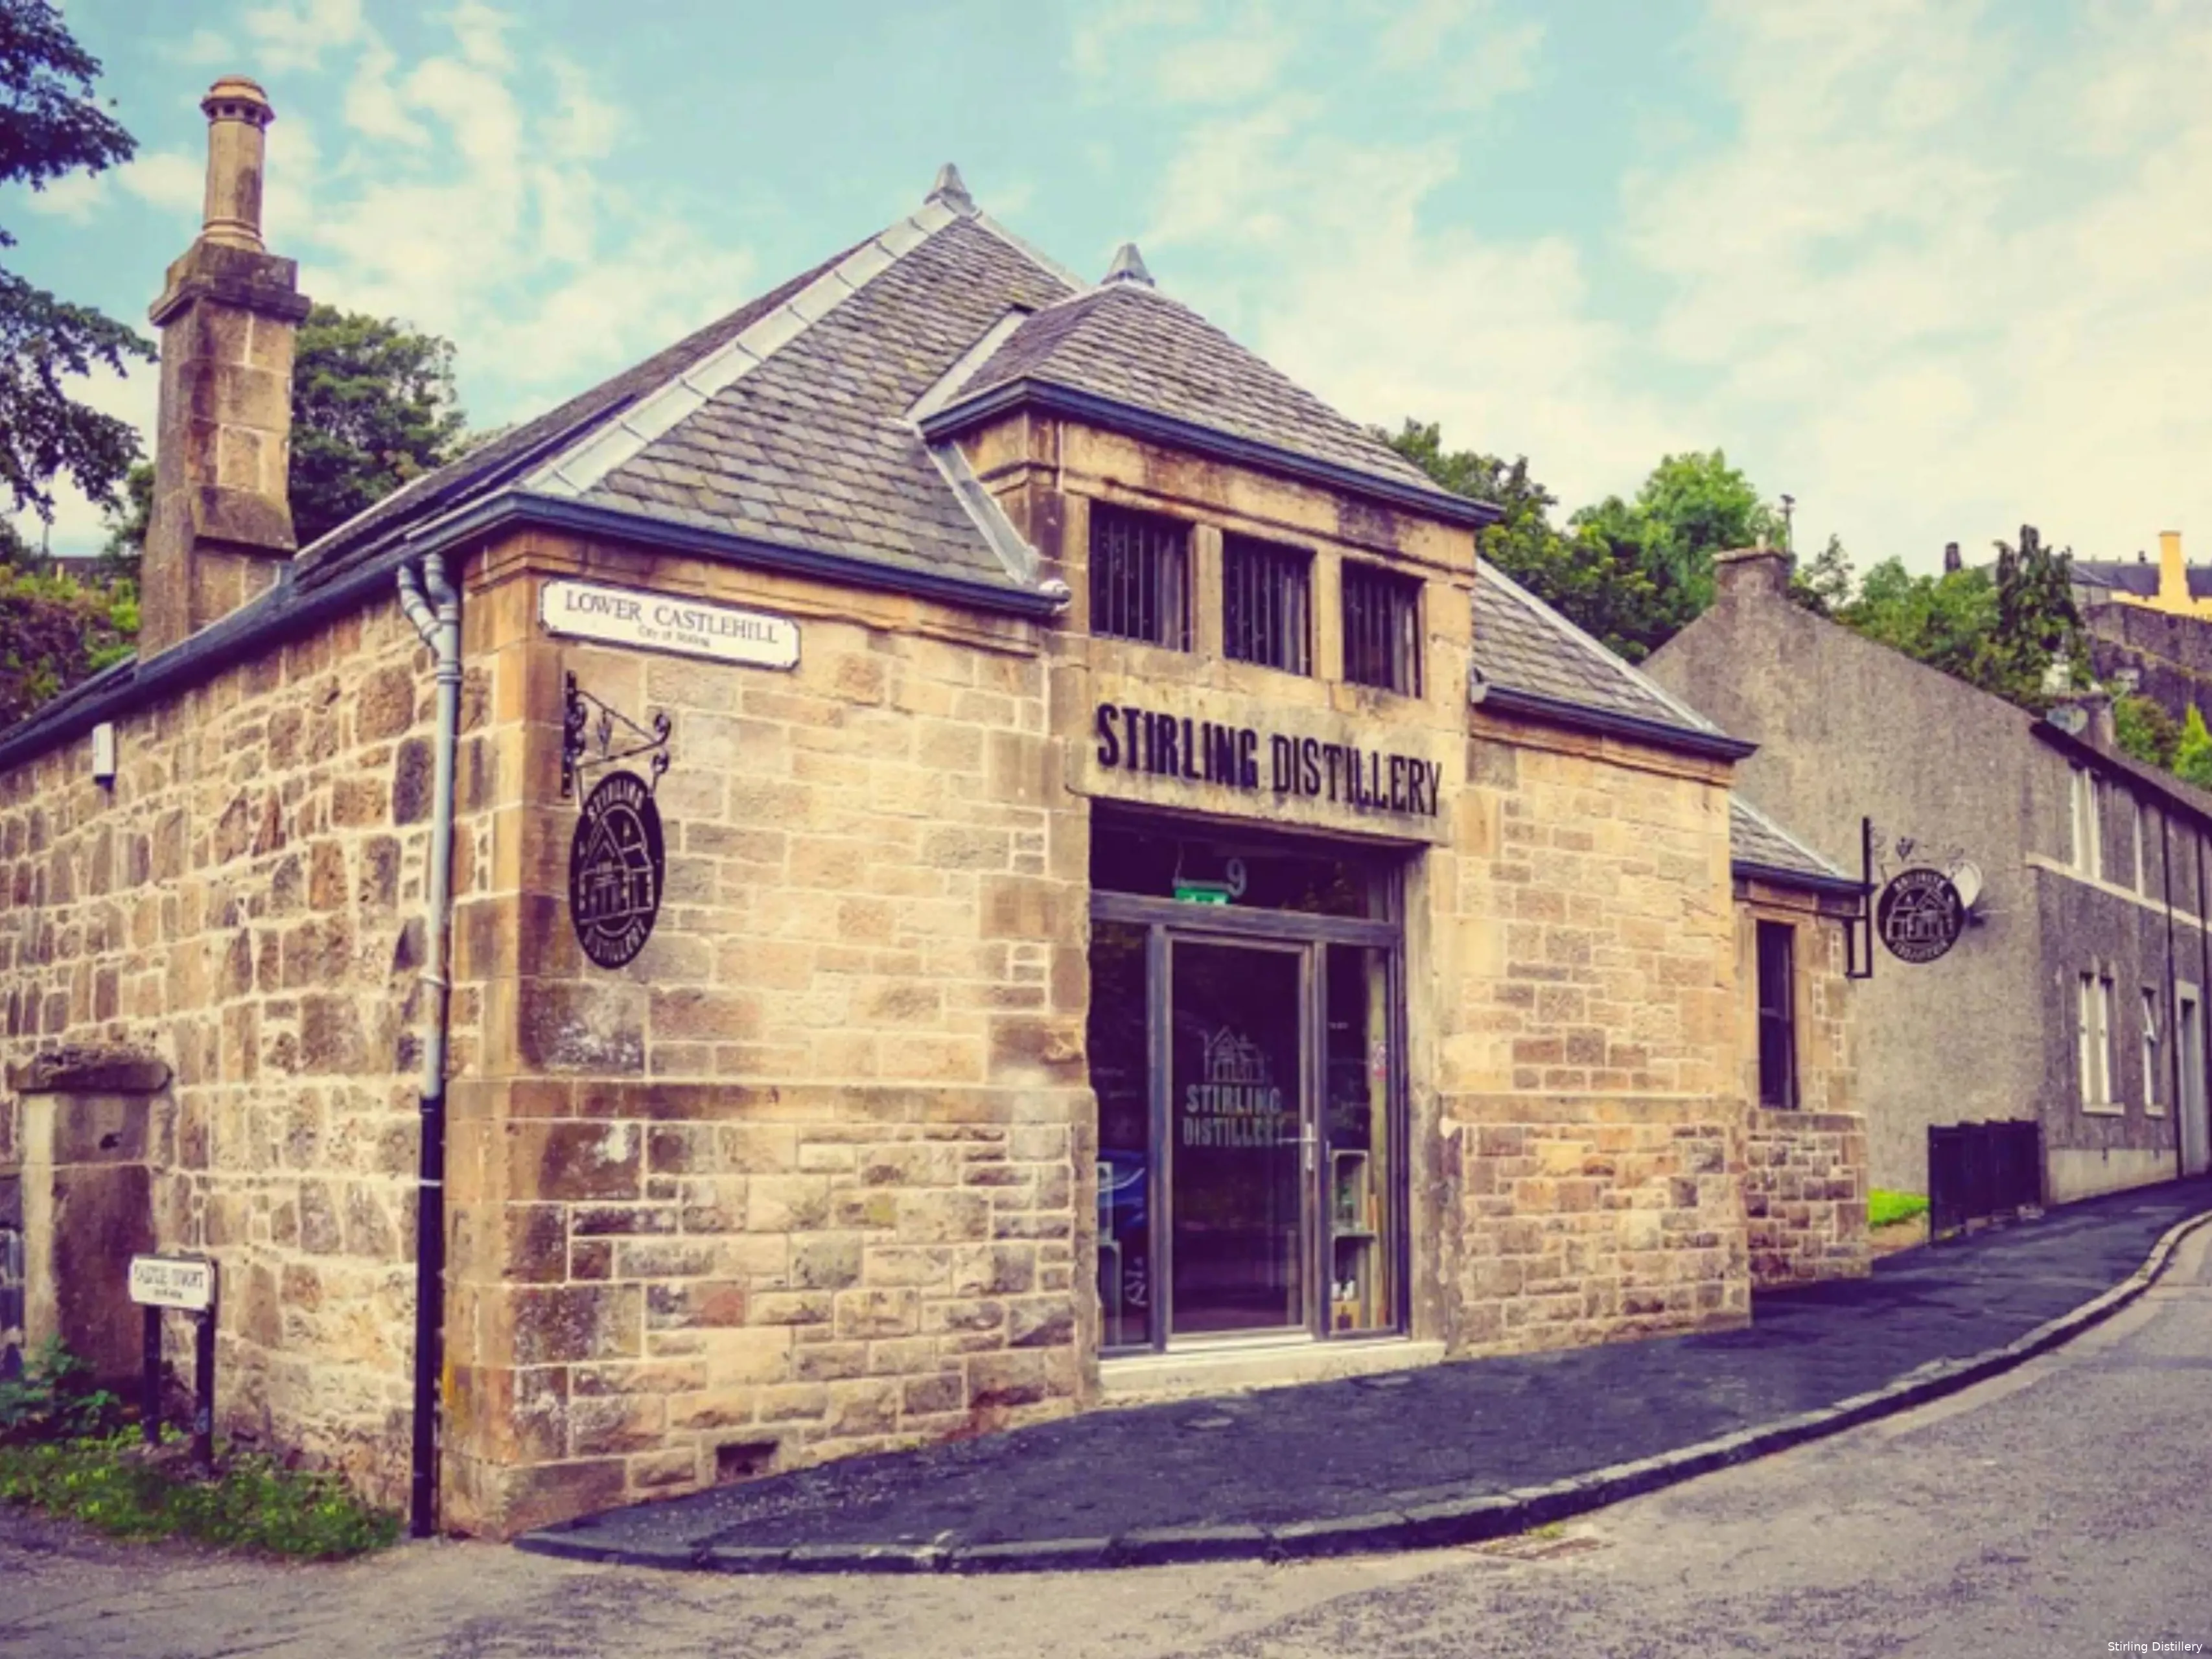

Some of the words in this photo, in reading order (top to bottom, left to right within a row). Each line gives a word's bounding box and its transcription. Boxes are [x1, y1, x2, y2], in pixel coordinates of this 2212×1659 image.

[565, 589, 642, 622] LOWER
[653, 605, 778, 644] CASTLEHILL
[1097, 703, 1259, 790] STIRLING
[1270, 733, 1442, 818] DISTILLERY
[1227, 857, 1247, 898] 9
[1185, 1084, 1281, 1115] STIRLING
[1182, 1116, 1286, 1148] DISTILLERY
